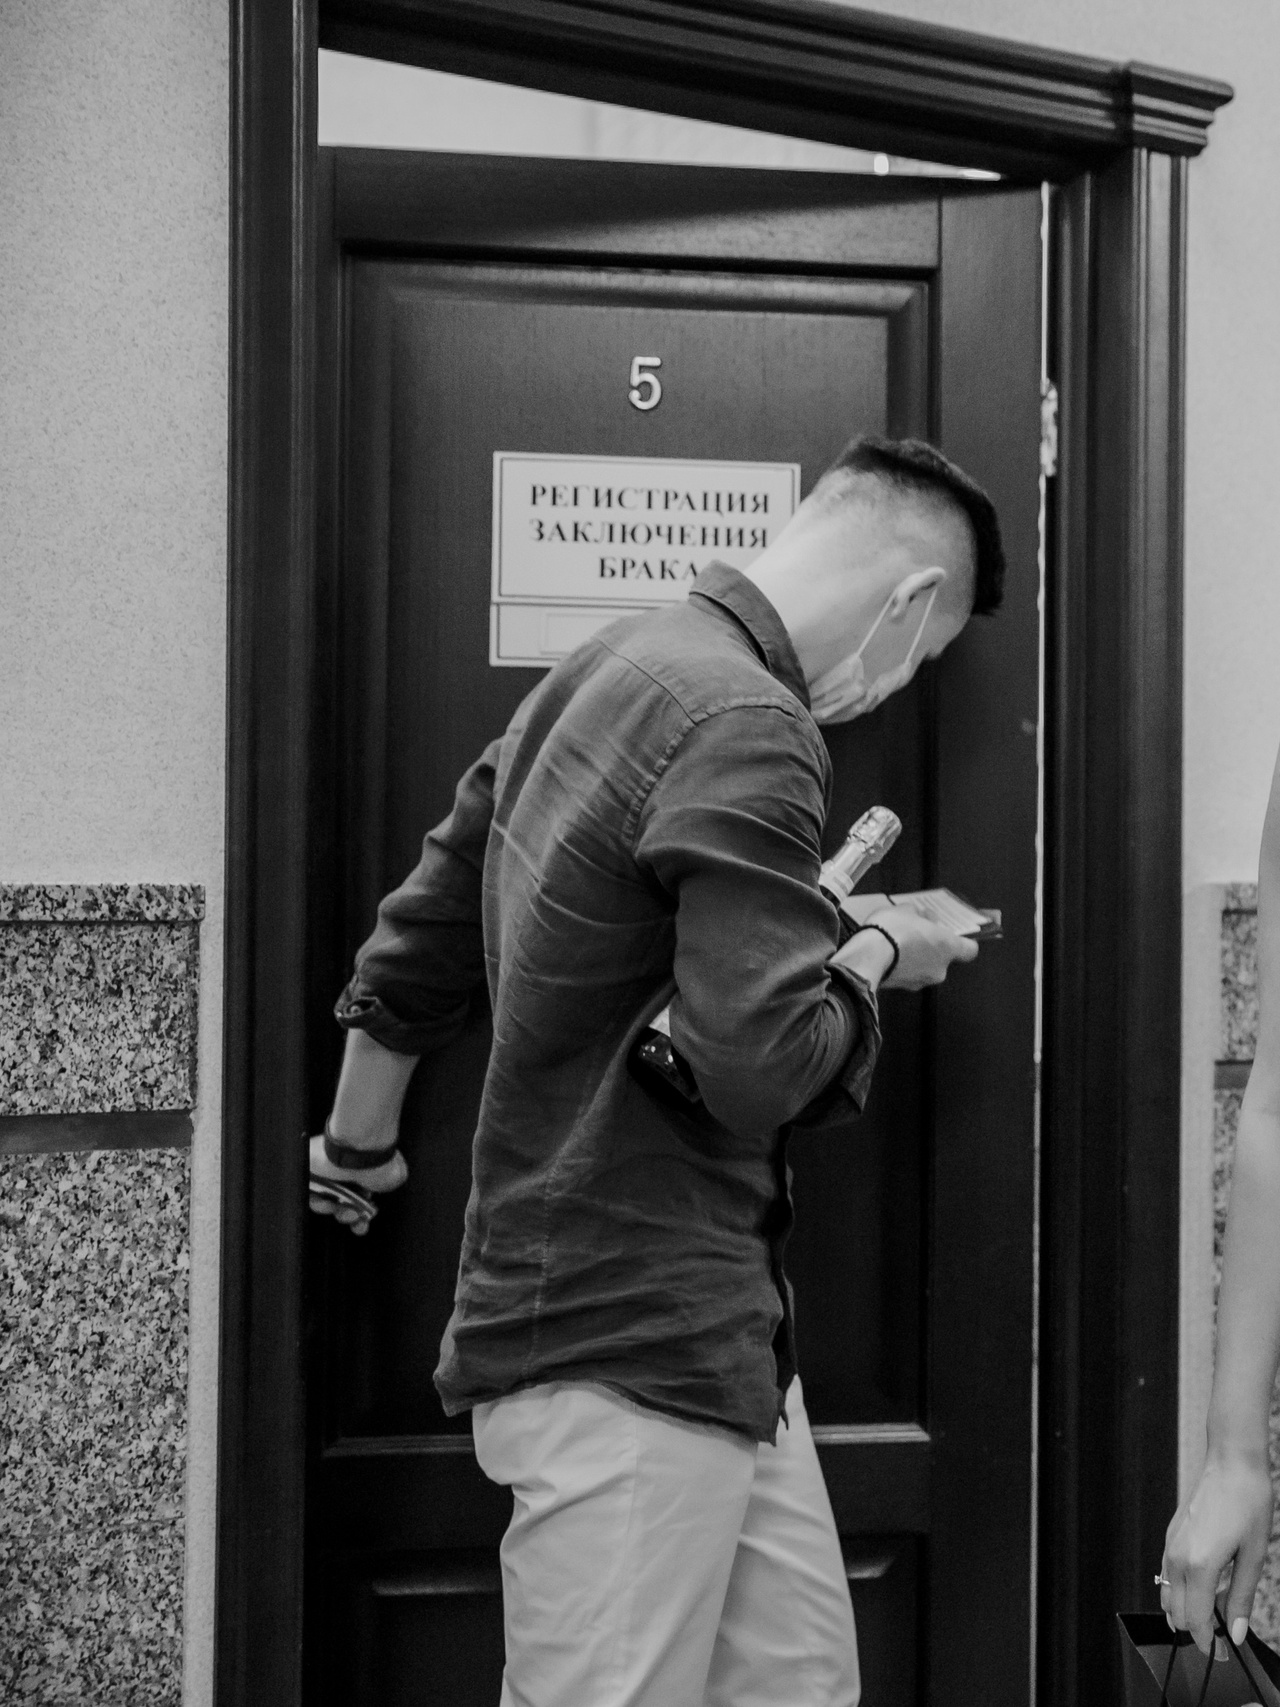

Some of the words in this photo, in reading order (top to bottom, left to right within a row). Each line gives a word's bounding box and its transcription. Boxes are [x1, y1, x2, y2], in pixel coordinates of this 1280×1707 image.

[629, 356, 662, 410] 5
[531, 484, 769, 516] РЕГИСТРАЦИЯ
[530, 519, 768, 548] ЗАКЛЮЧЕНИЯ
[600, 557, 698, 581] БРАКА
